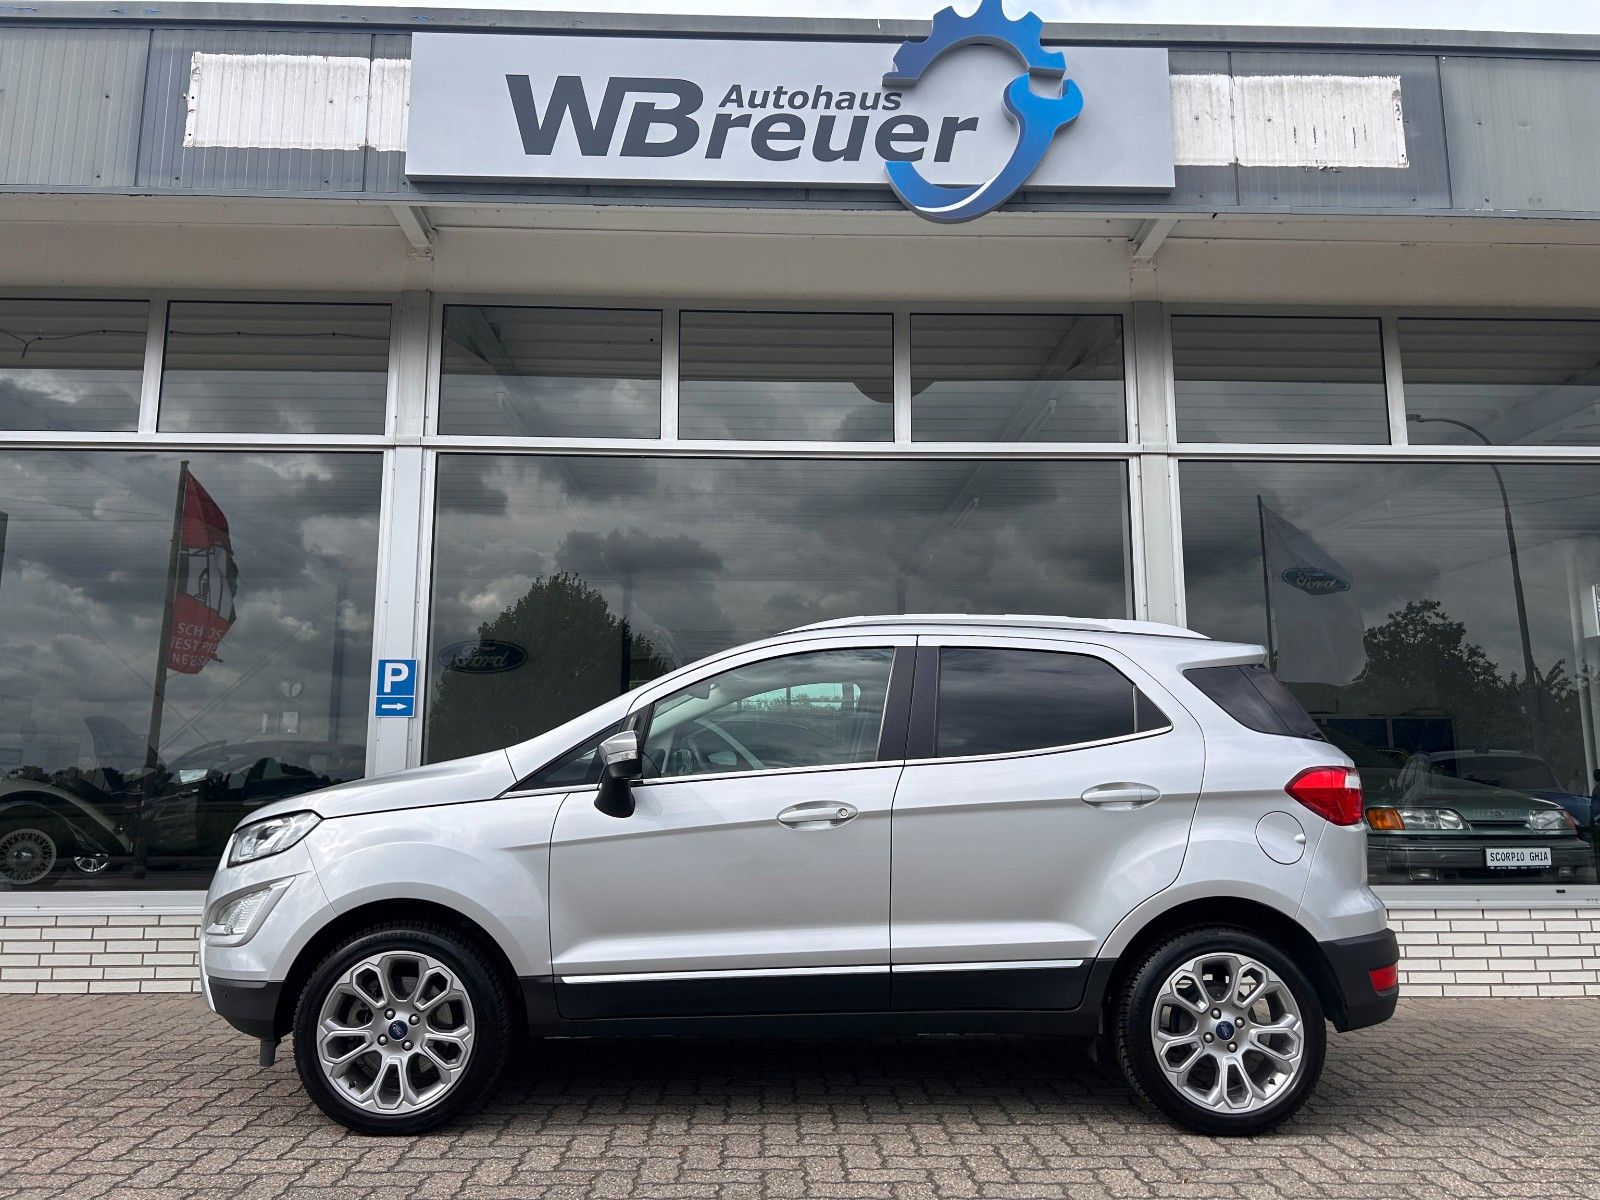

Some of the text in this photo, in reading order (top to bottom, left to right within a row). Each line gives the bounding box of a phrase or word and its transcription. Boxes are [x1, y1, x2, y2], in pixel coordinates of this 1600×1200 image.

[718, 84, 902, 110] Autohaus
[383, 662, 409, 693] P
[1490, 851, 1549, 862] SCORPIO GHIA
